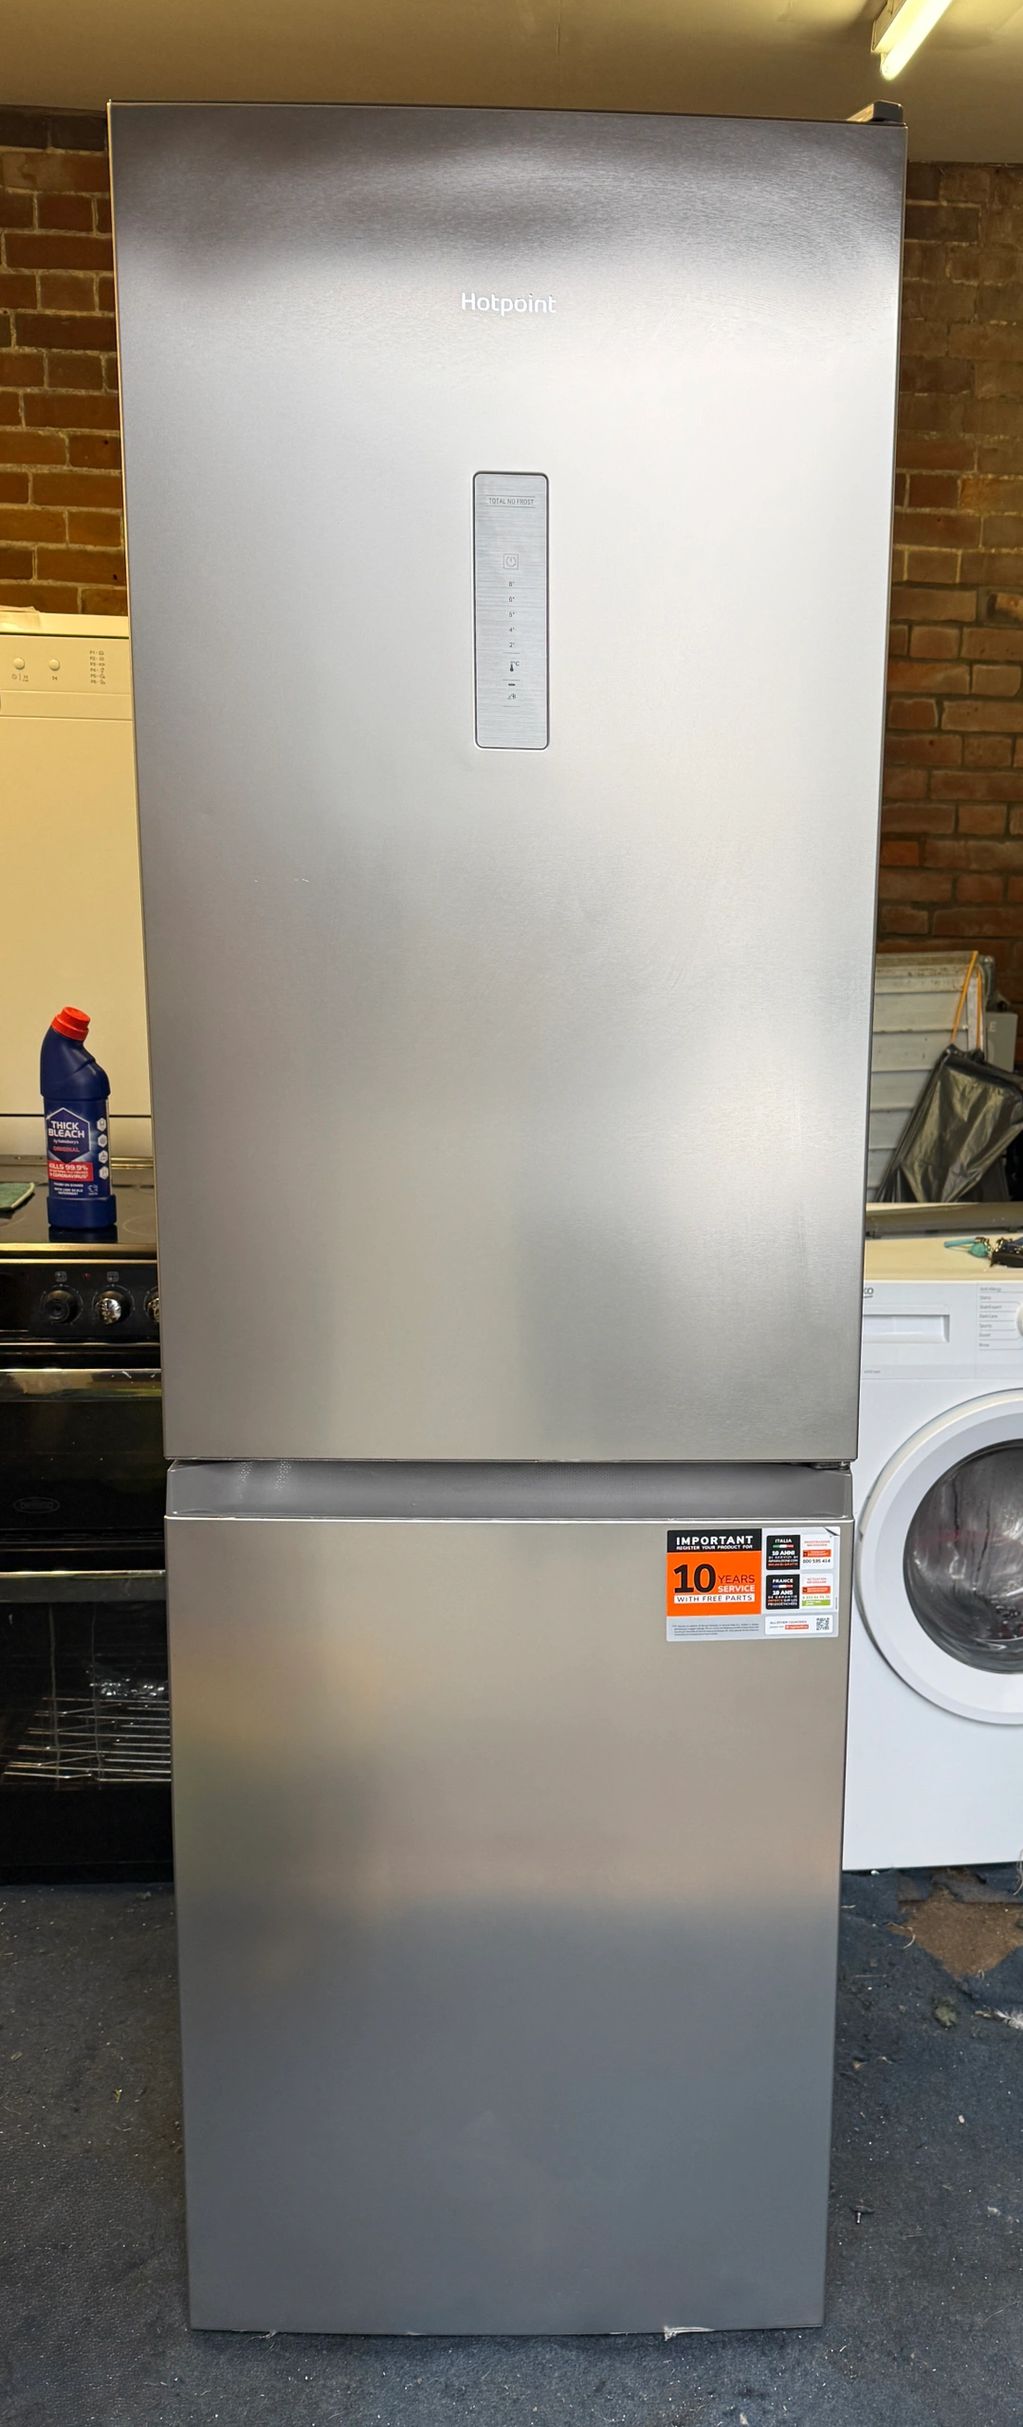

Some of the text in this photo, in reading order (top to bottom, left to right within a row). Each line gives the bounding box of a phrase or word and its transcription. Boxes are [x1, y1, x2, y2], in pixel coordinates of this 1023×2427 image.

[461, 292, 557, 317] Hotpoint
[488, 497, 506, 505] TOTAL
[516, 498, 535, 506] FROST
[50, 1120, 79, 1131] THICK
[48, 1128, 85, 1139] BLEACH
[676, 1535, 753, 1546] IMPORTANT
[673, 1563, 716, 1594] 10
[717, 1574, 756, 1584] YEARS
[717, 1584, 756, 1593] SERVICE
[725, 1594, 753, 1602] PARTS
